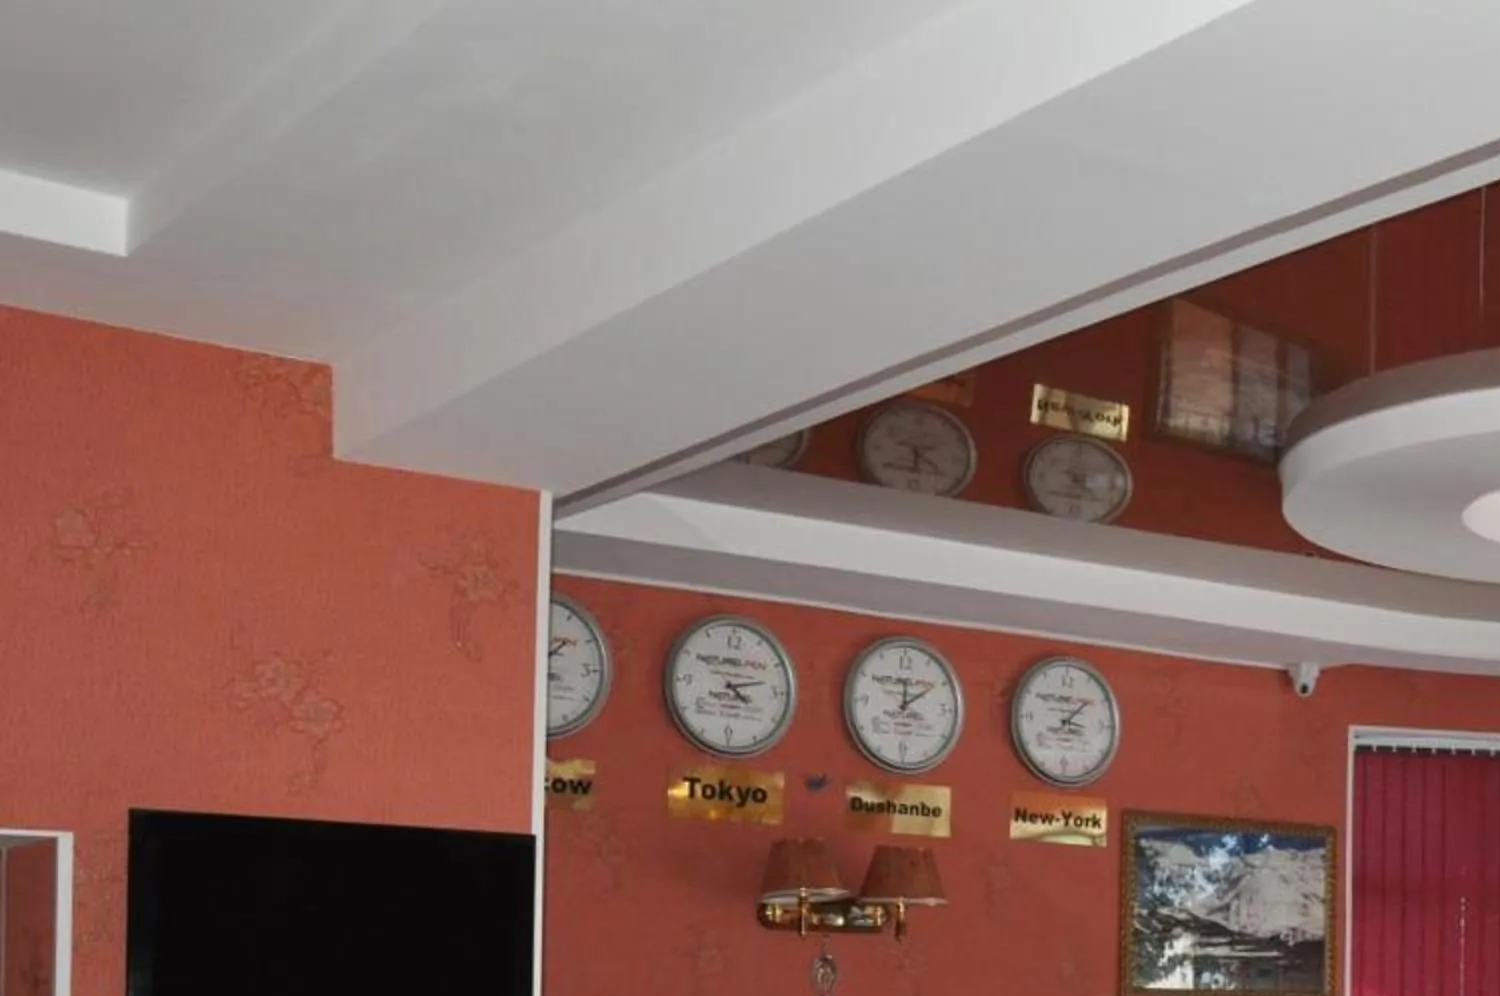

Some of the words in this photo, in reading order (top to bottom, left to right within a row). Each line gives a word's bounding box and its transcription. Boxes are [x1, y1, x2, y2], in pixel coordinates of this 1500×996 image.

[682, 777, 768, 808] Tokyo
[849, 796, 942, 818] Dushanbe
[1014, 807, 1102, 829] New-York
